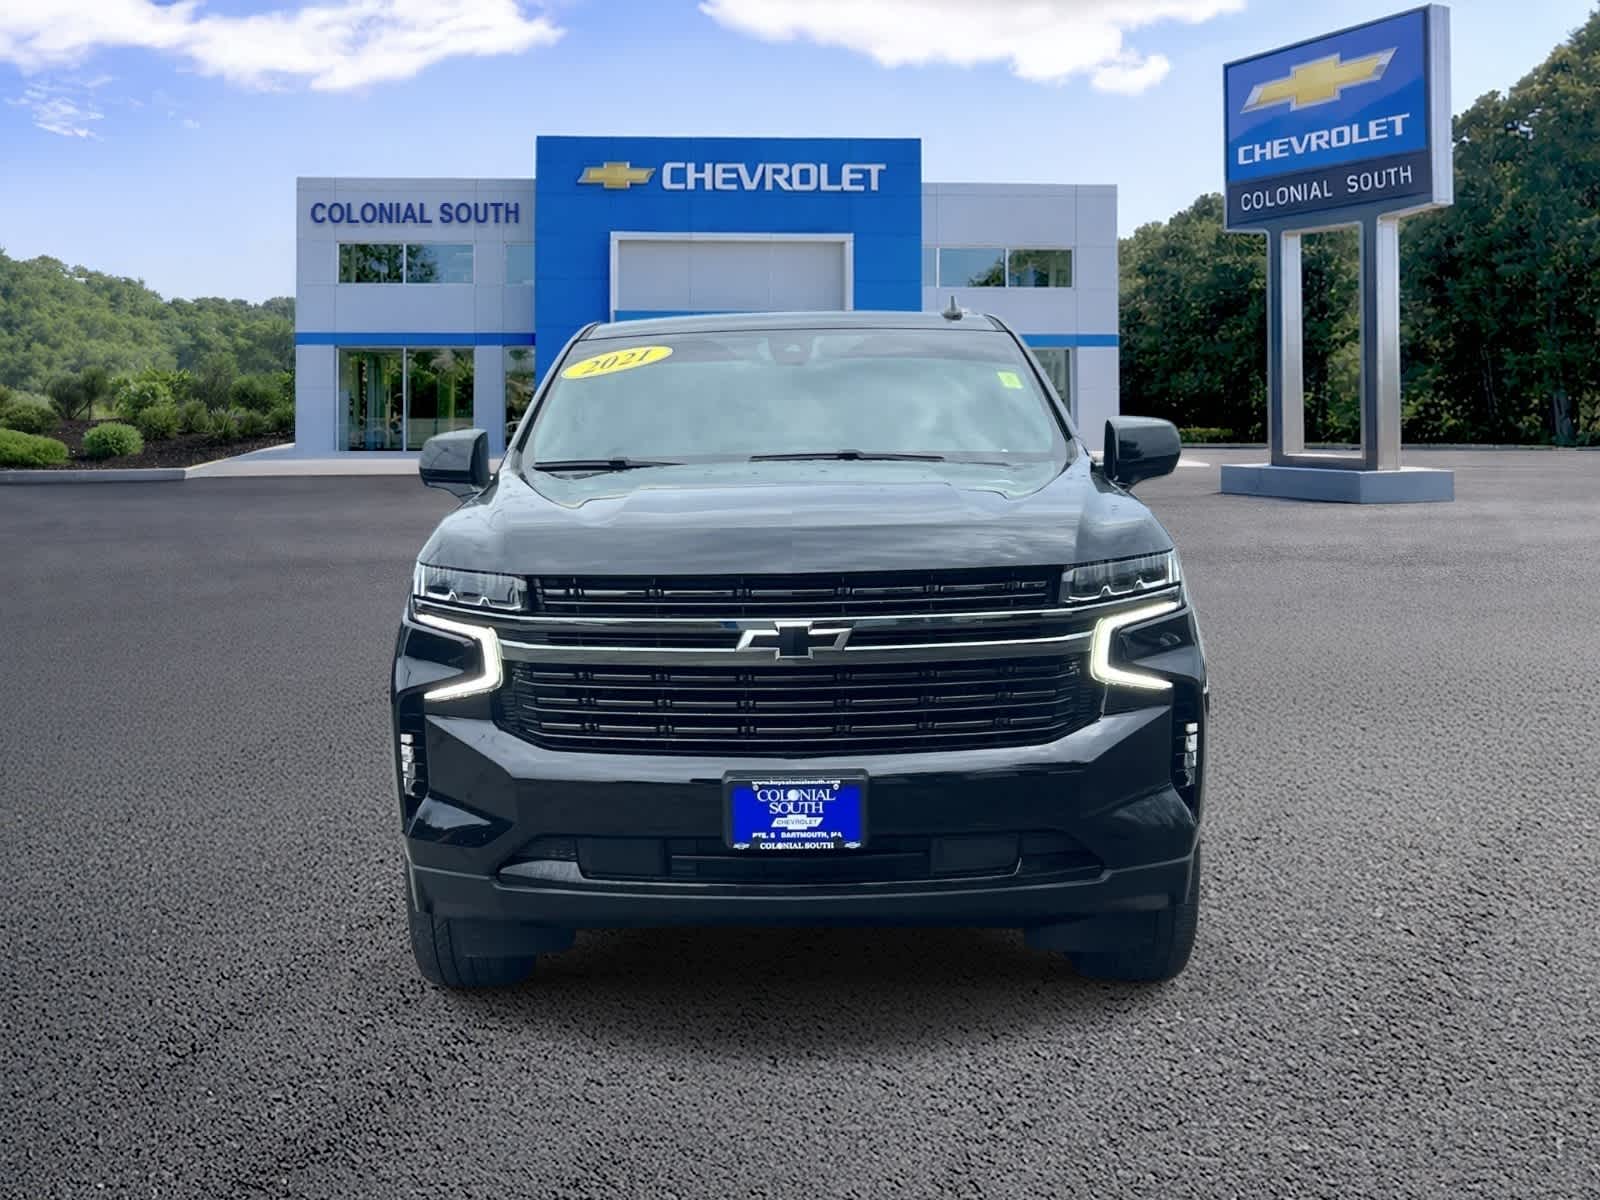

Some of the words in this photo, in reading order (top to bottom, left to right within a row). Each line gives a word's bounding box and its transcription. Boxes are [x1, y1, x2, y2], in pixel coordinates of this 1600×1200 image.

[1238, 113, 1410, 164] CHEVROLET
[661, 162, 887, 191] CHEVROLET
[1241, 180, 1332, 211] COLONIAL
[1346, 165, 1413, 193] SOUTH
[310, 202, 432, 225] COLONIAL
[439, 201, 520, 224] SOUTH
[581, 349, 652, 374] 2021
[757, 789, 836, 802] COLONIAL
[769, 801, 824, 814] SOUTH
[760, 842, 803, 850] COLONIAL
[804, 841, 834, 849] SOUTH
